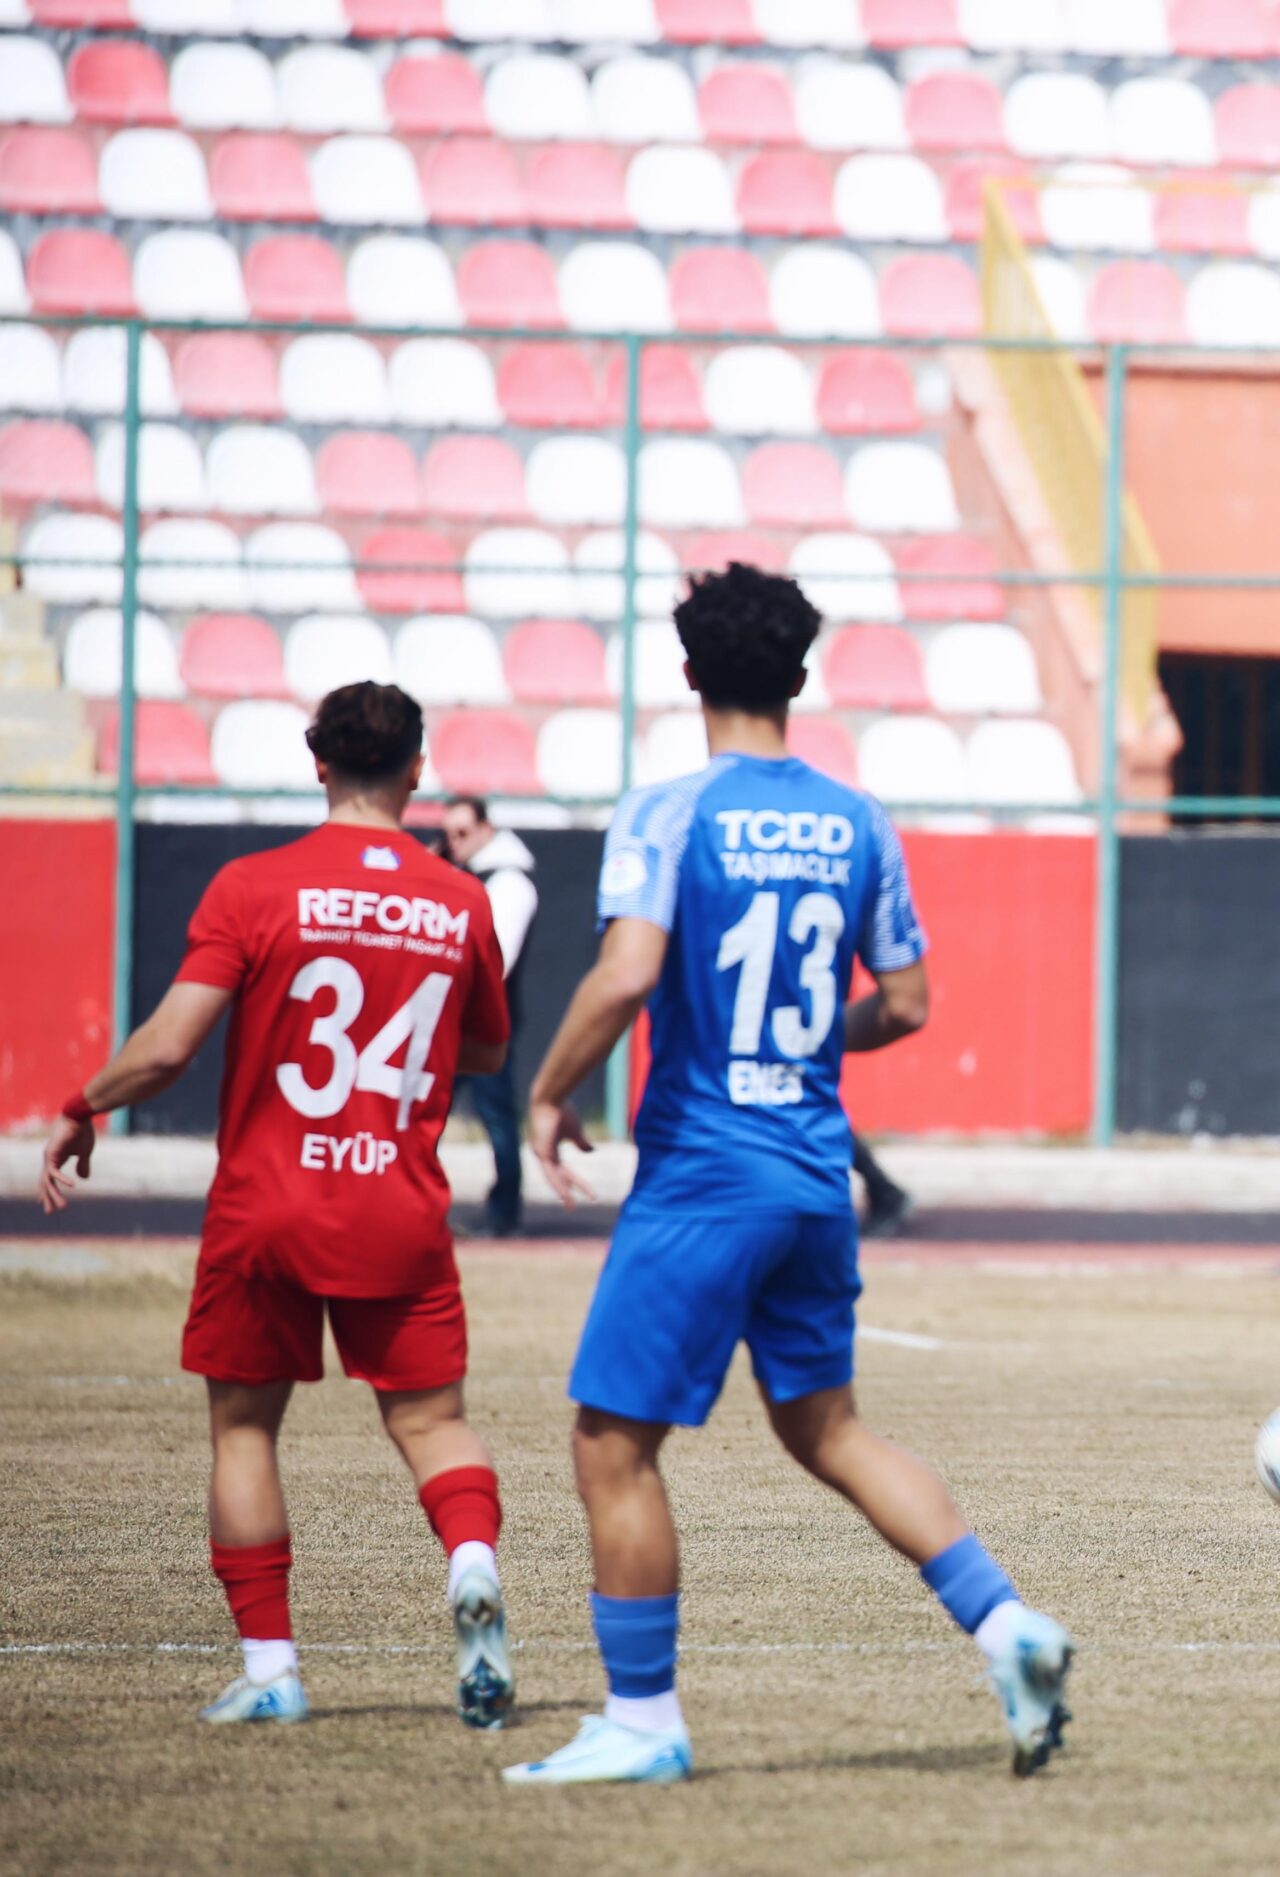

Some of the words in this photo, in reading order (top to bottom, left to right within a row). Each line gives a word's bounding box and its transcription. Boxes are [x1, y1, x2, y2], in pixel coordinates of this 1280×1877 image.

[715, 809, 854, 855] TCDD
[298, 888, 470, 945] REFORM
[716, 891, 845, 1059] 13
[276, 956, 453, 1132] 34
[300, 1132, 398, 1175] EYÜP
